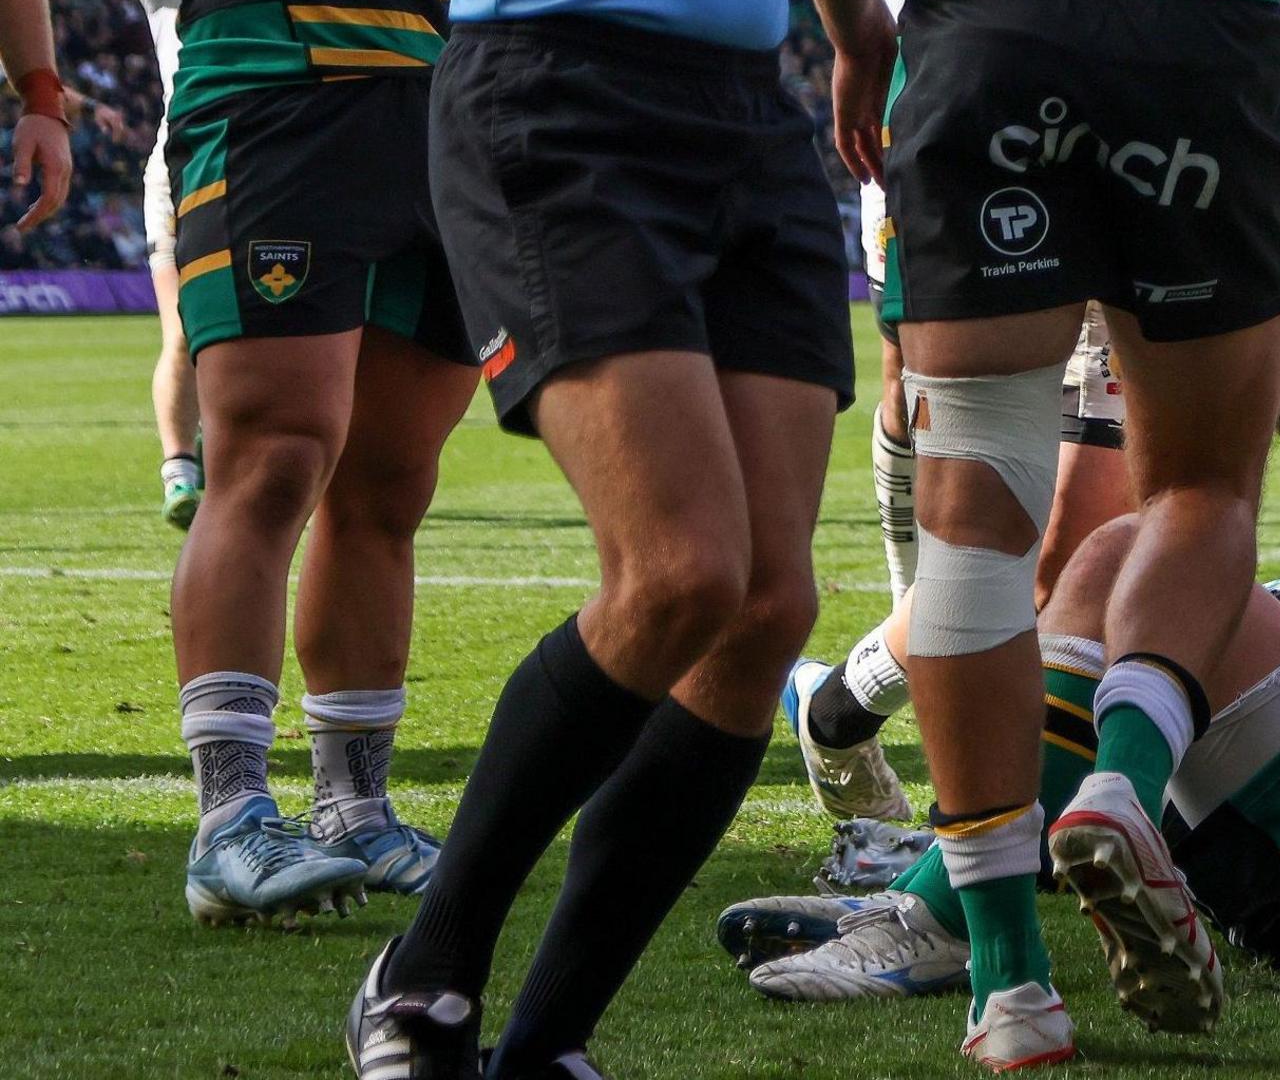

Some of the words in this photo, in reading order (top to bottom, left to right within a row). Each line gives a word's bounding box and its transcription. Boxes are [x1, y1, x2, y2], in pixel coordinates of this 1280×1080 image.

[988, 97, 1220, 209] cinch
[260, 252, 300, 261] SAINTS
[981, 262, 1015, 278] Travis
[1018, 256, 1060, 273] Perkins
